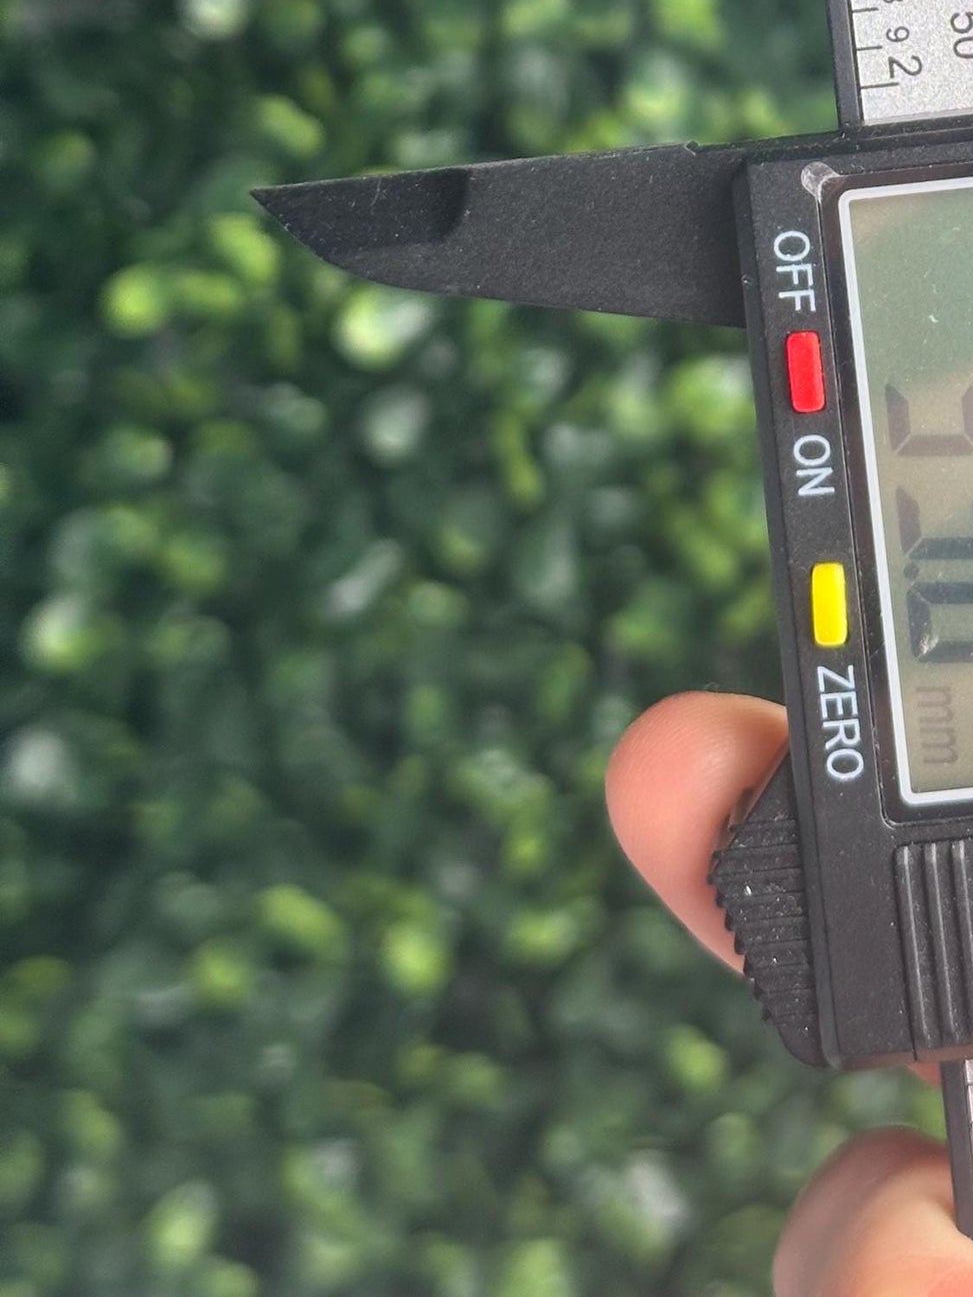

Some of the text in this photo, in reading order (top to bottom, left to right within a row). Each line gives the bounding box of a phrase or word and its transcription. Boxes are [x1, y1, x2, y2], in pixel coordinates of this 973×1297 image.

[886, 26, 910, 43] 9
[888, 55, 923, 79] 2
[773, 230, 816, 312] OFF
[793, 434, 835, 496] ON
[817, 664, 864, 780] ZERO
[915, 685, 959, 764] mm
